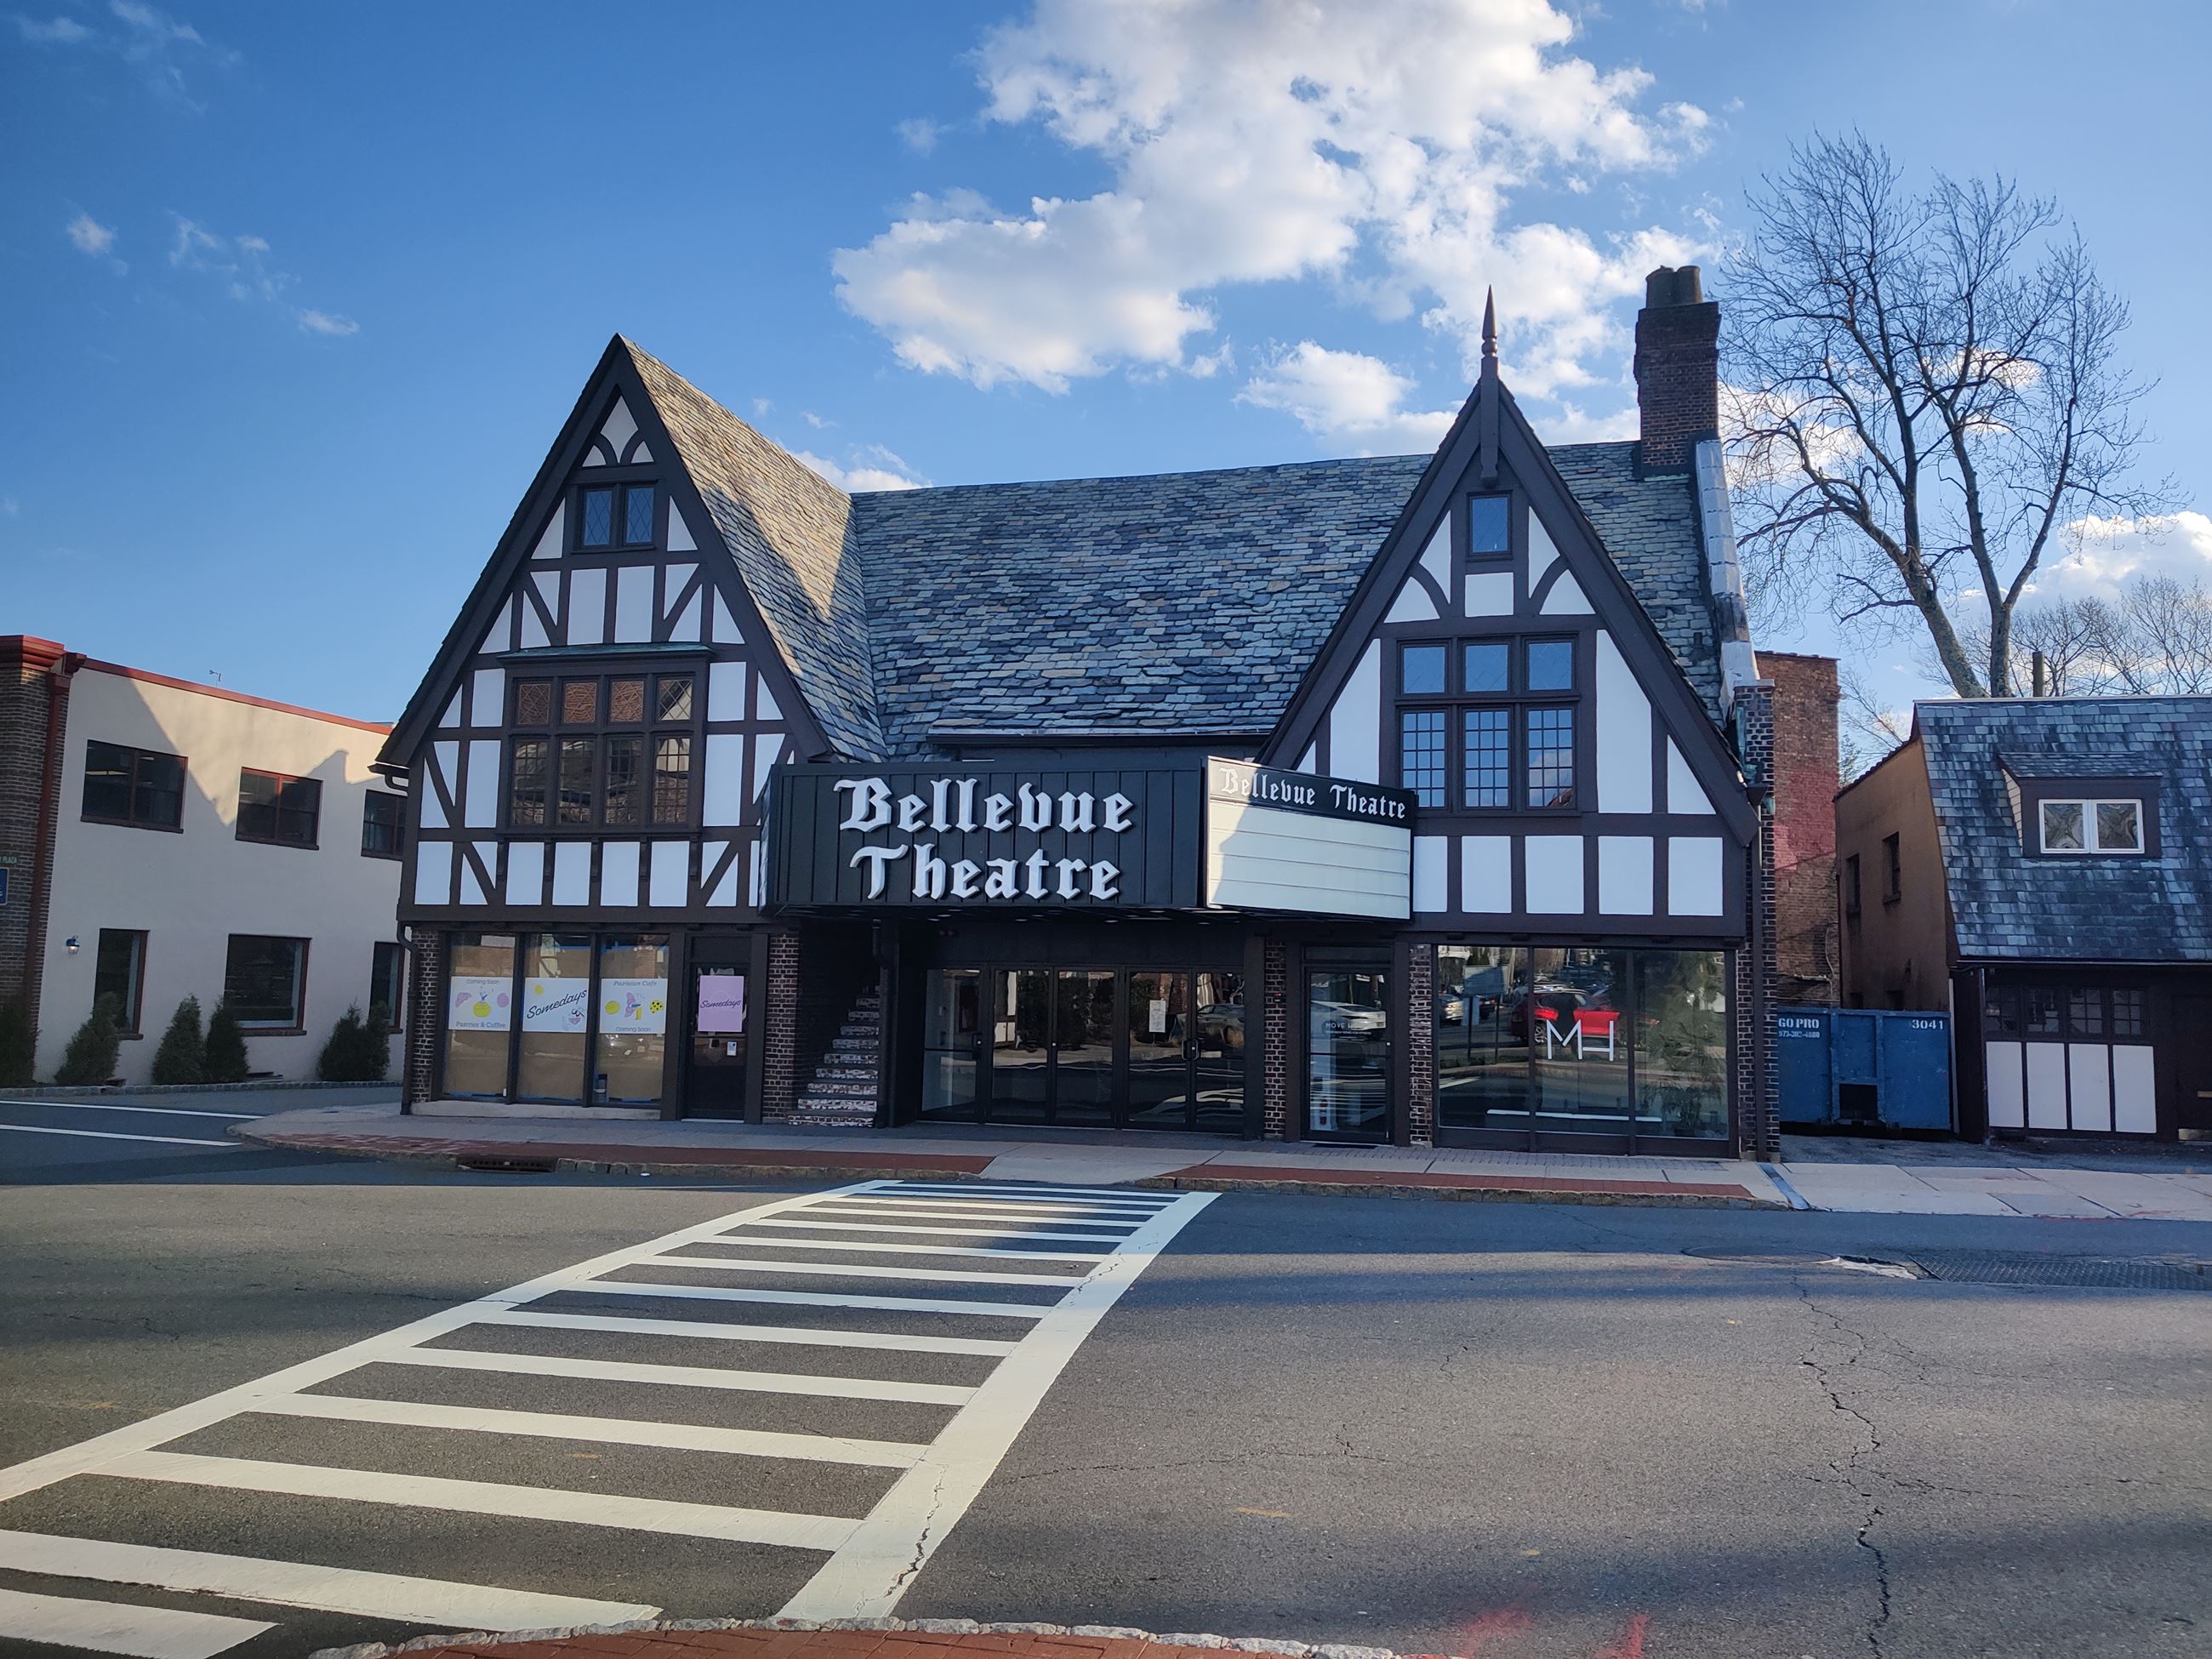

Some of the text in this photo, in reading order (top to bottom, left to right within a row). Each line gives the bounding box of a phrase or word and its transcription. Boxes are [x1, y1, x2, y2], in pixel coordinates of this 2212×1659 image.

[833, 777, 1134, 833] Bellevue
[1219, 767, 1406, 819] Bellevue Theatre
[849, 843, 1121, 899] Theatre
[527, 989, 588, 1019] Somedays
[699, 999, 742, 1009] Somedays
[1778, 1018, 1820, 1029] GO PRO
[1912, 1019, 1944, 1029] 3041
